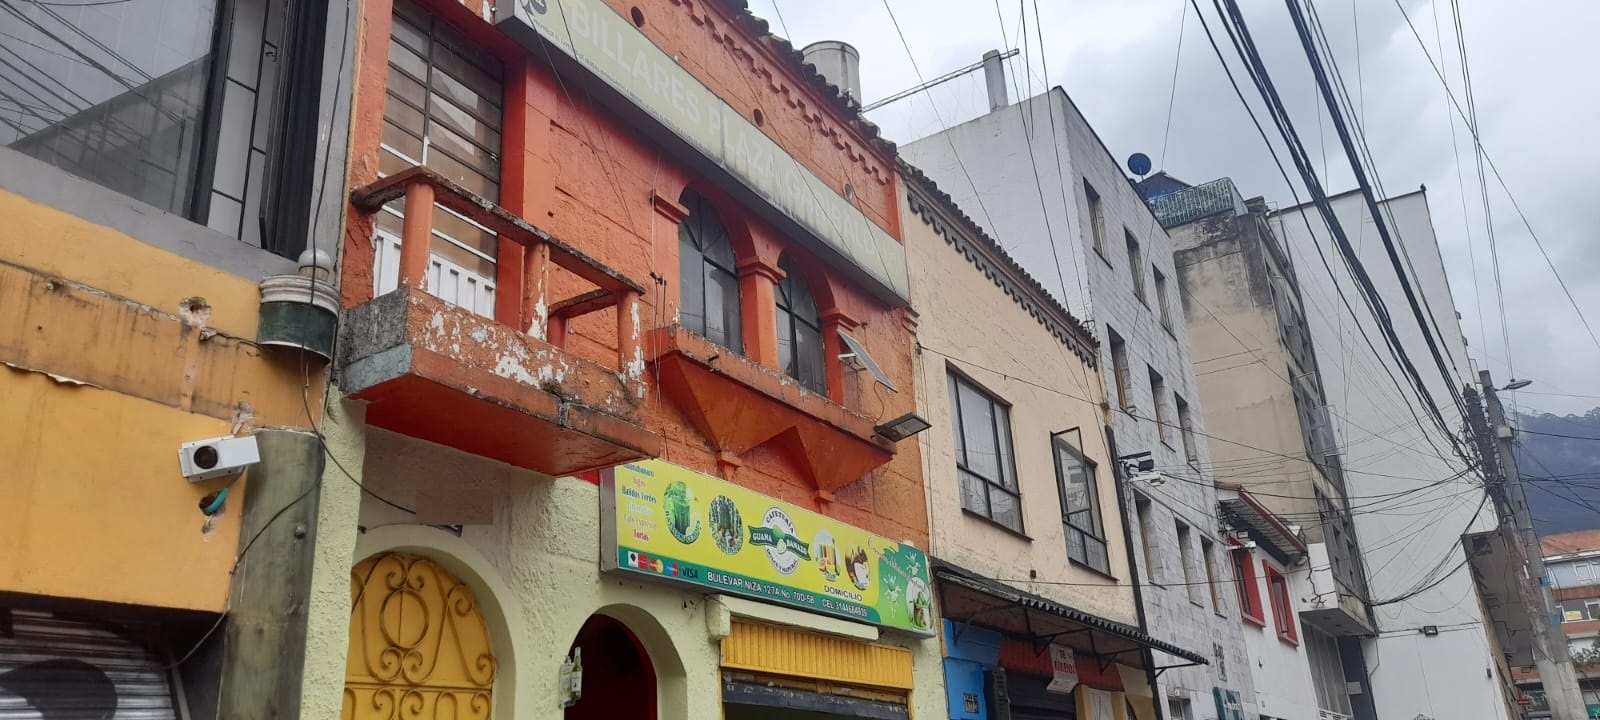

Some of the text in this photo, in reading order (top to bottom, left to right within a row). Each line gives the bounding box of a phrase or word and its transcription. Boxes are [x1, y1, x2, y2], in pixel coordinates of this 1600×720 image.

[571, 1, 701, 125] BILLARES
[708, 104, 776, 182] PLAZA
[752, 532, 773, 543] GUANA
[682, 568, 699, 579] VISA
[707, 571, 743, 587] BULEVAR
[744, 580, 762, 592] NIZA
[823, 585, 863, 602] DOMICILIO
